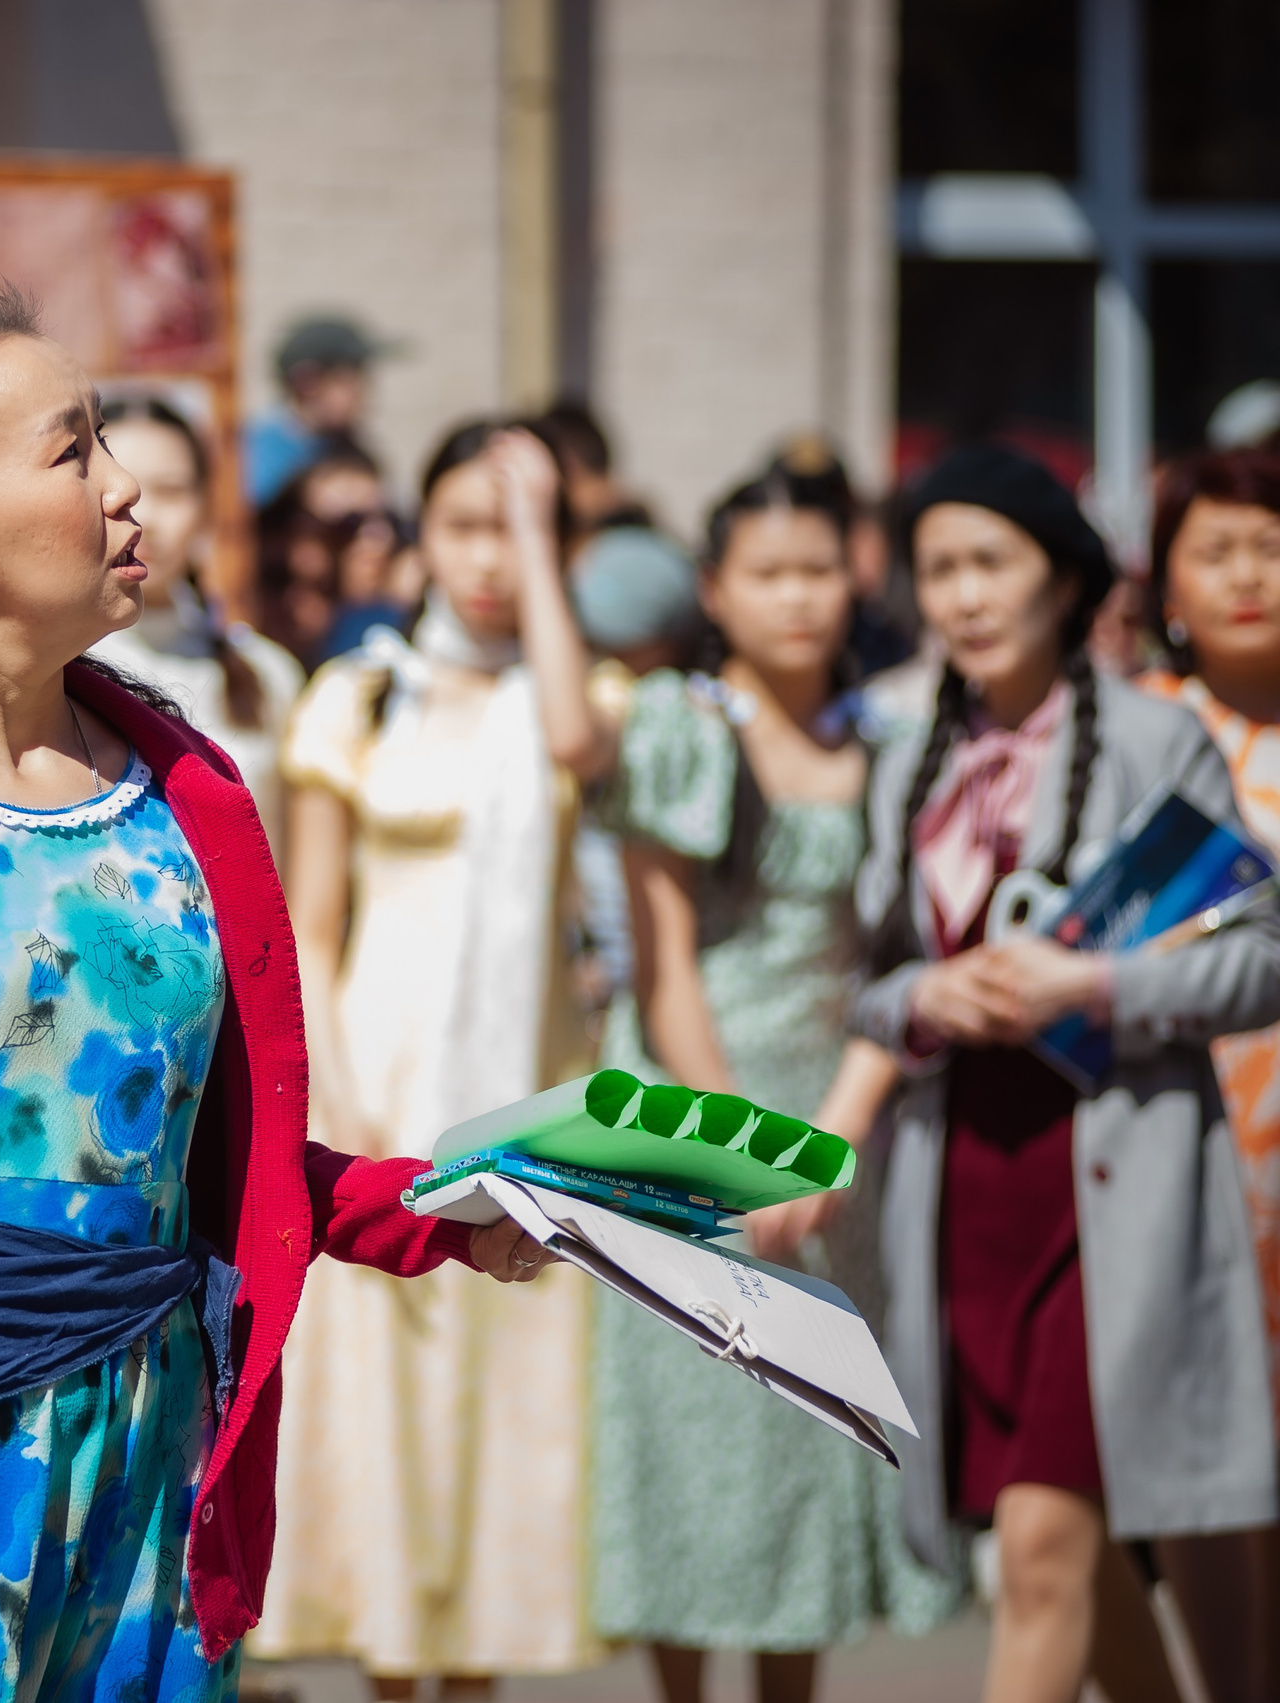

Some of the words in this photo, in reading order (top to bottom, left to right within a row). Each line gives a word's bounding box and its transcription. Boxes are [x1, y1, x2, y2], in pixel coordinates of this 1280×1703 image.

[521, 1165, 551, 1180] ЦВЕТНЫЕ
[551, 1171, 589, 1189] КАРАНДАШИ
[655, 1199, 665, 1209] 12
[537, 1161, 578, 1177] ЦВЕТНЫЕ
[580, 1170, 638, 1190] КАРАНДАШИ
[644, 1184, 655, 1195] 12
